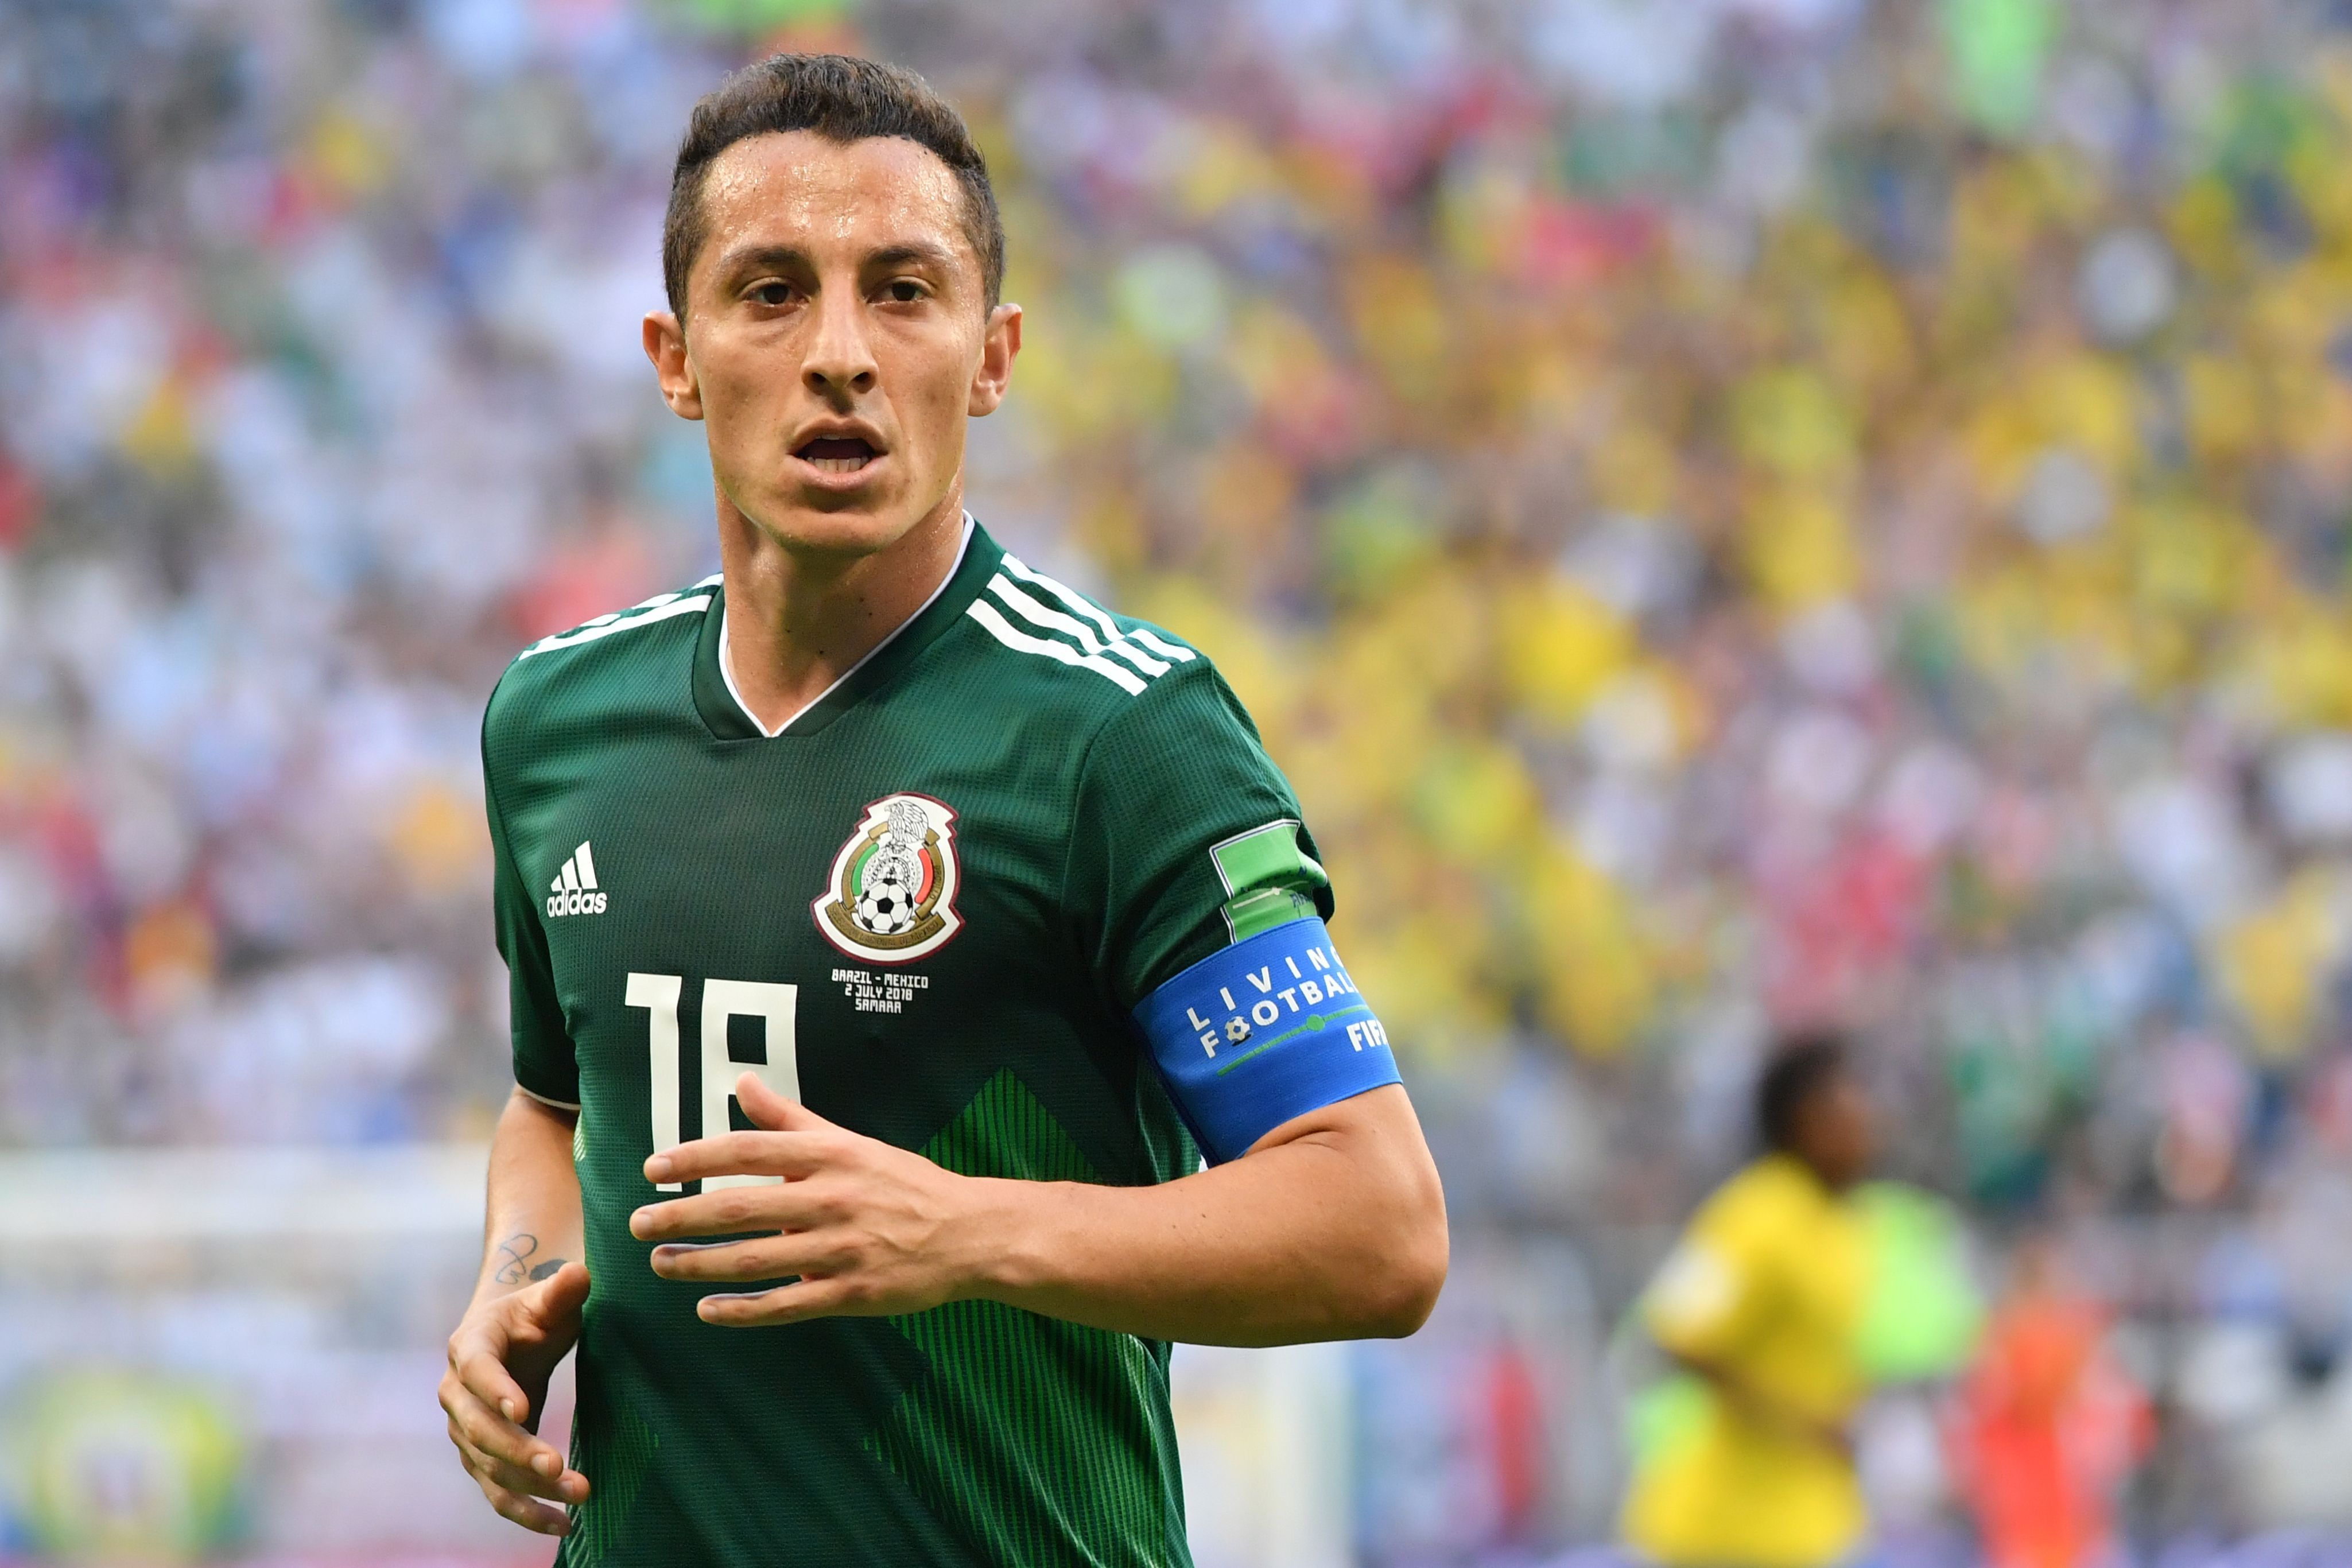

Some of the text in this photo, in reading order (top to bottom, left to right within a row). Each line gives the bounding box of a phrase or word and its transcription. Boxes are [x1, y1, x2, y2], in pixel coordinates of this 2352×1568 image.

[547, 887, 607, 918] adidas
[831, 968, 872, 985] BRAZIL
[884, 973, 929, 989] MEXICO
[844, 983, 913, 1001] 2 JULY 2018
[855, 998, 902, 1014] SAMARA
[624, 972, 803, 1194] 18
